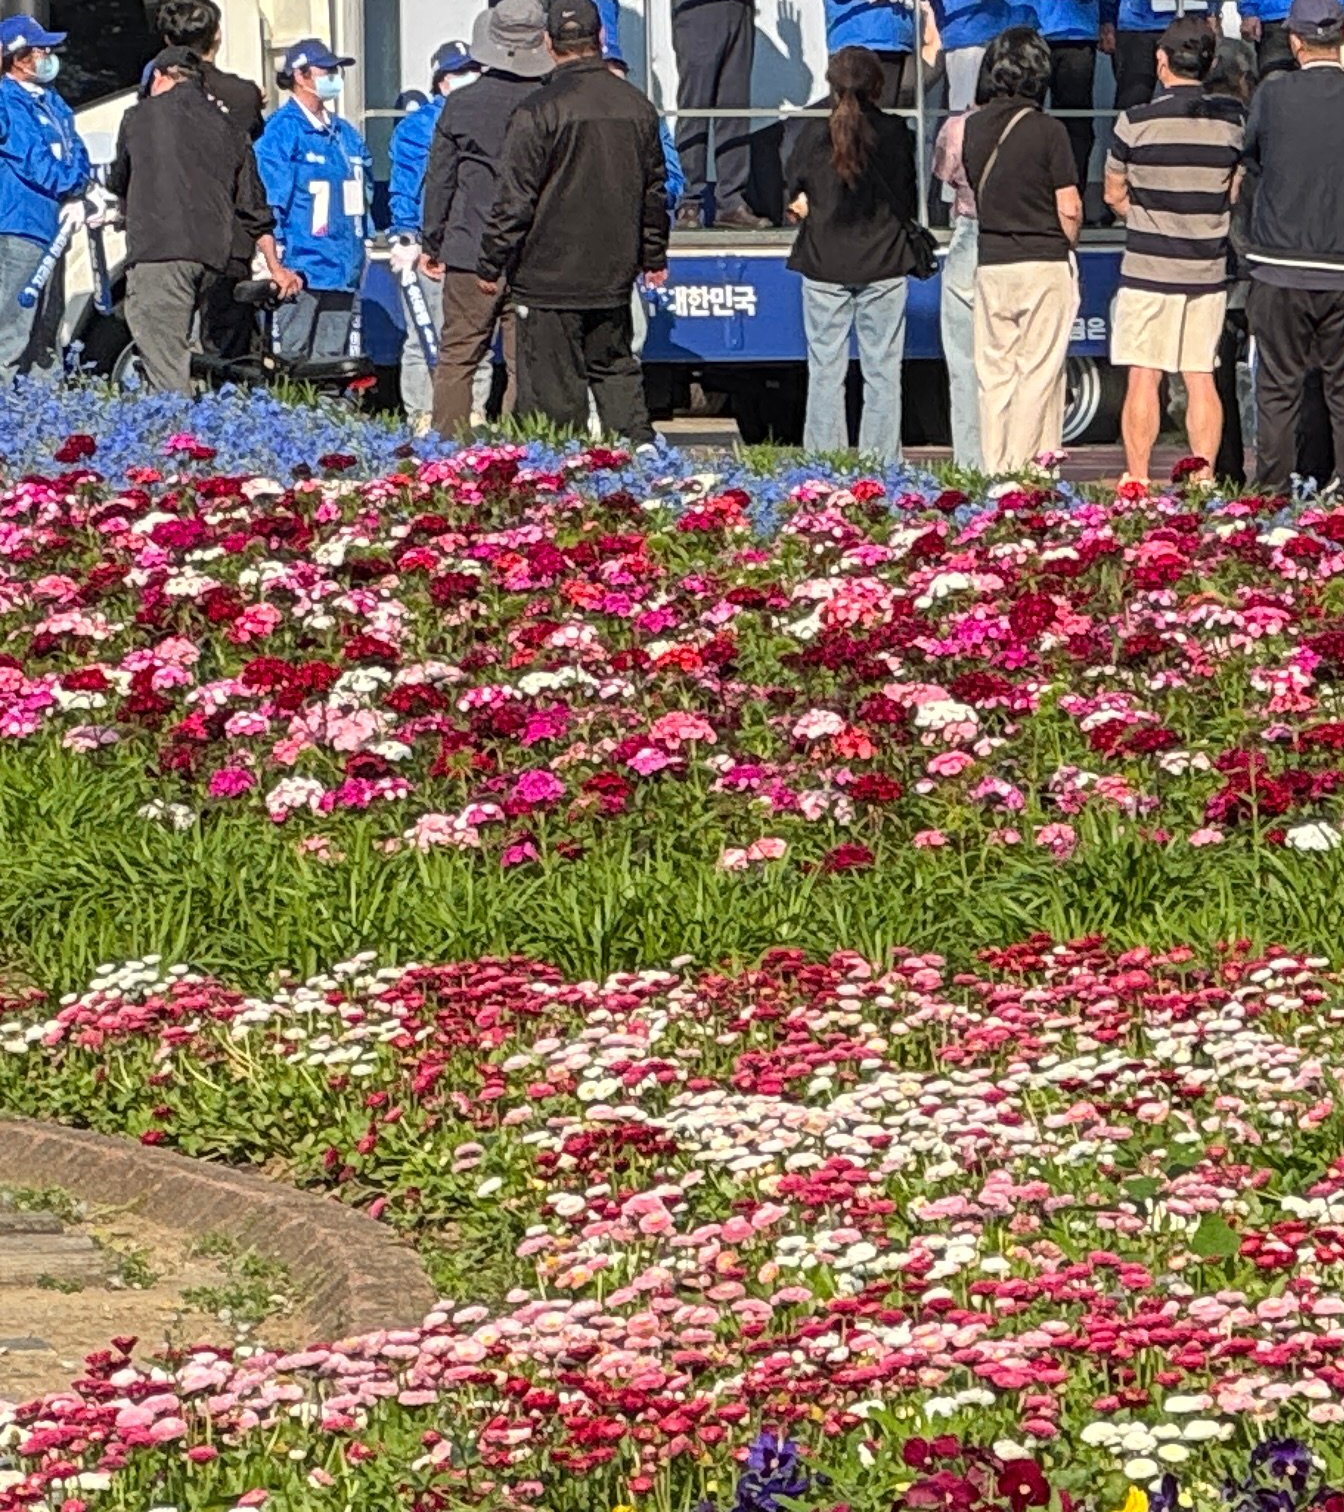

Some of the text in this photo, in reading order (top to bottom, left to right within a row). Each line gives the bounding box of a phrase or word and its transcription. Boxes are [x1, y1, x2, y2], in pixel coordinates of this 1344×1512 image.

[309, 181, 330, 236] 1
[667, 285, 757, 317] 대한민국
[1070, 317, 1106, 342] 금은
